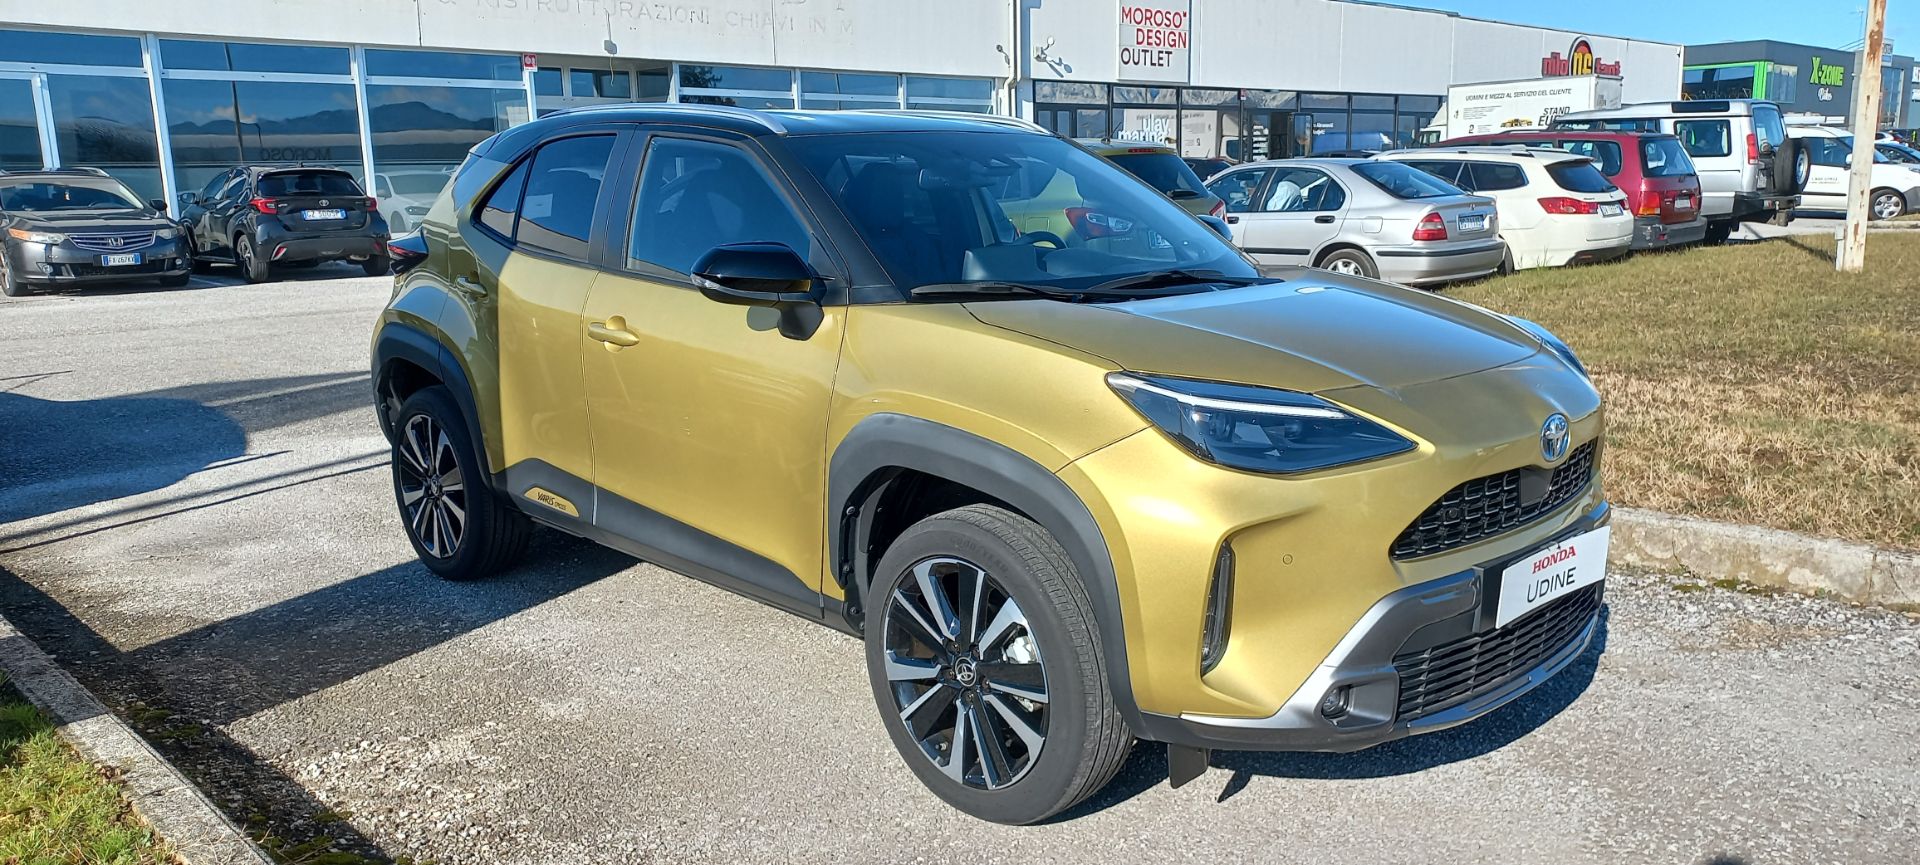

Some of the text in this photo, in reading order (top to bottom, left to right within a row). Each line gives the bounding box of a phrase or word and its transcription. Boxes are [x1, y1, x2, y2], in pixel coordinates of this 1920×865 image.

[726, 11, 794, 31] CHIAVI
[809, 16, 826, 33] IN
[1121, 6, 1183, 29] MOROSO
[1136, 28, 1187, 49] DESIGN
[1121, 47, 1173, 67] OUTLET
[1810, 57, 1845, 86] X-ZONE
[1513, 90, 1538, 98] SERVIZIO
[1549, 88, 1572, 96] CLIENTE
[1543, 106, 1571, 116] STAND
[536, 491, 555, 506] YARIS
[1532, 545, 1577, 575] HONDA
[1526, 566, 1577, 603] UDINE
